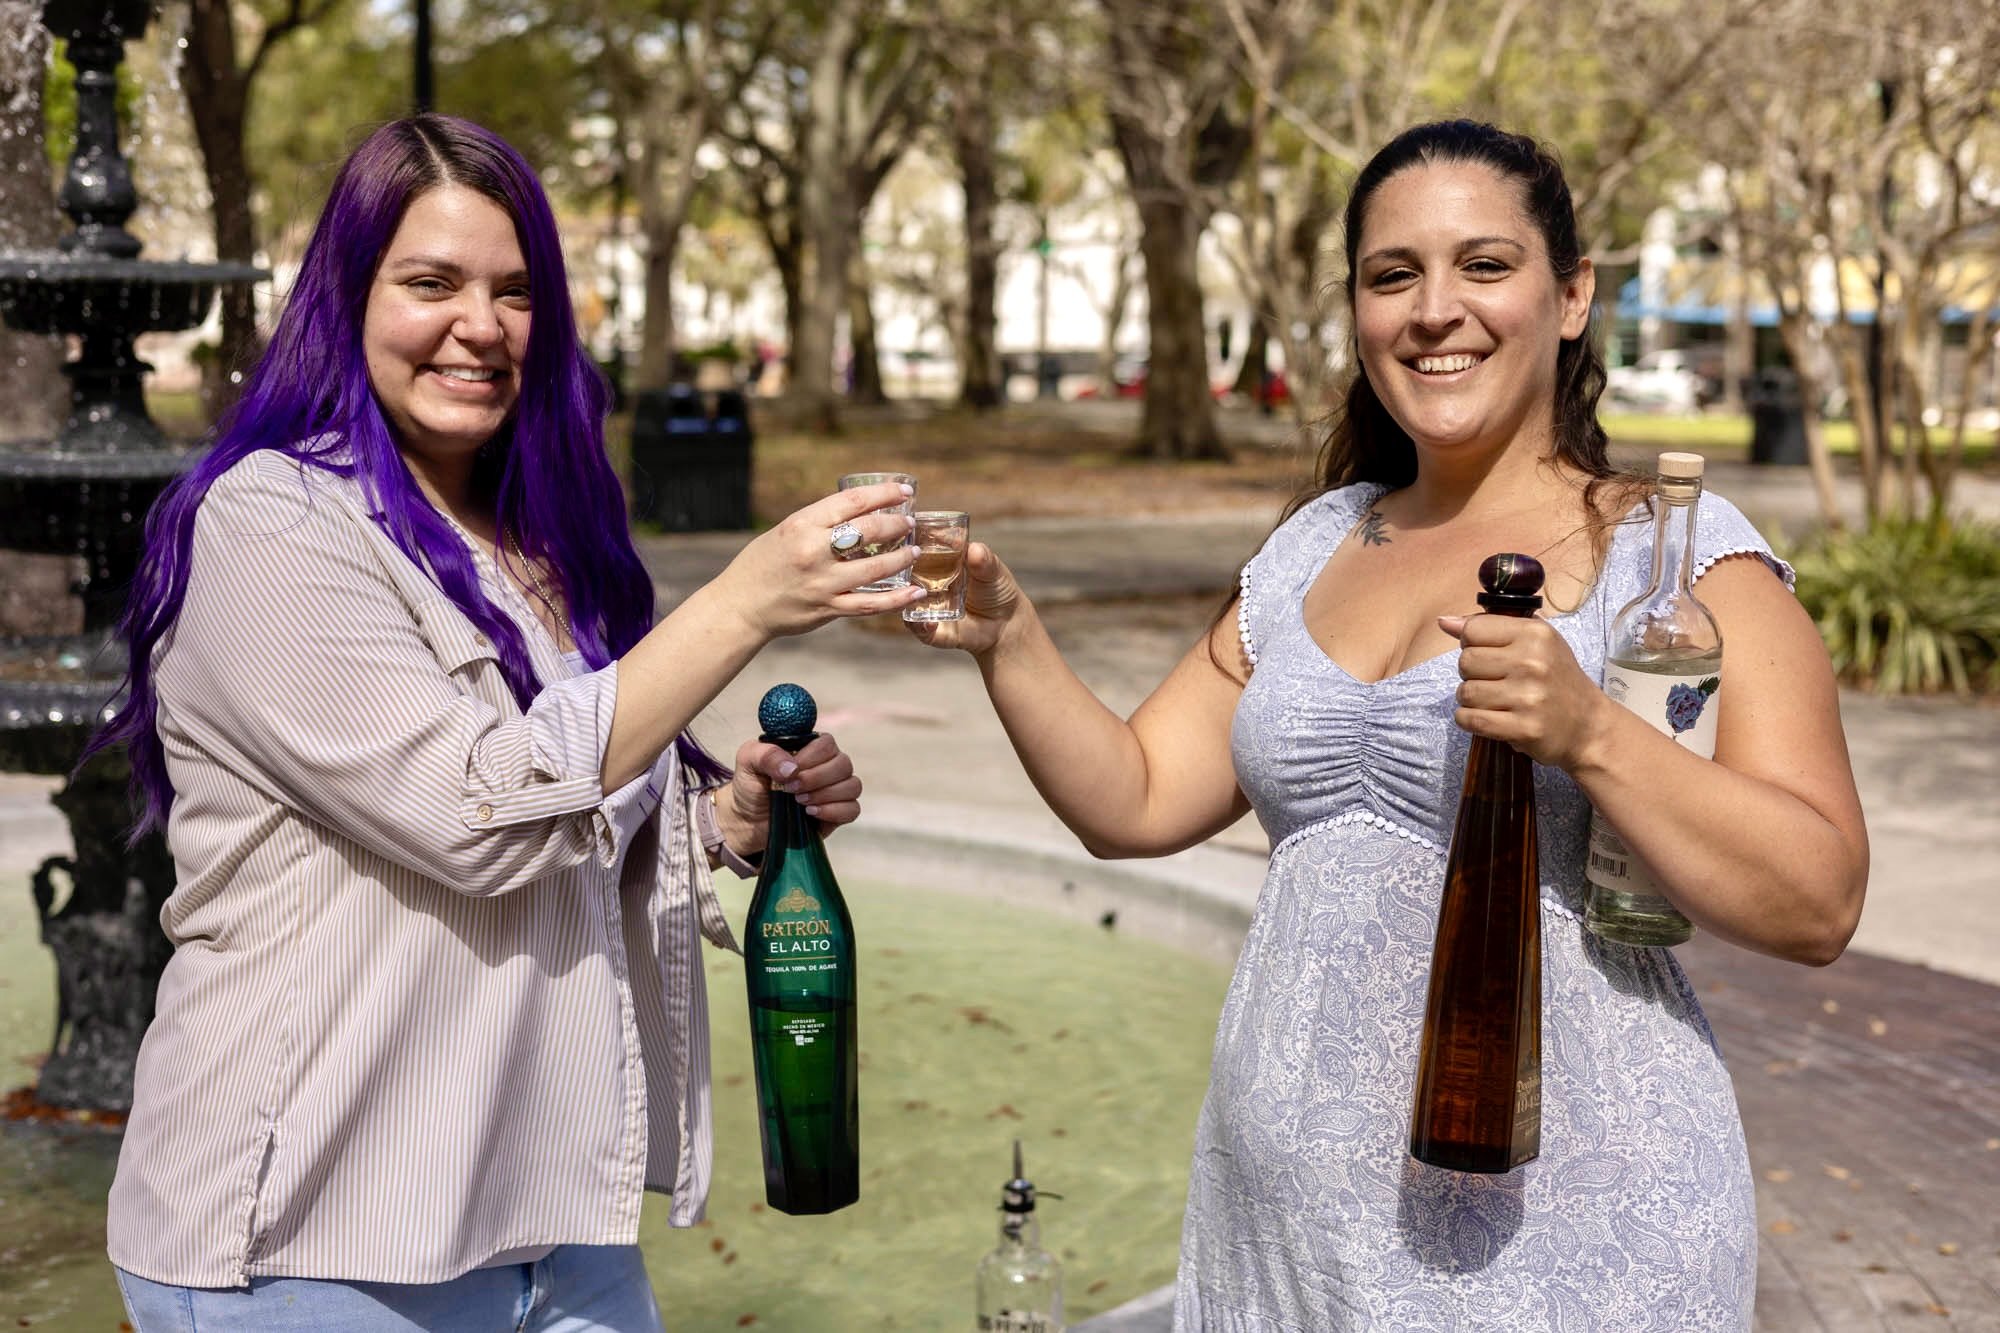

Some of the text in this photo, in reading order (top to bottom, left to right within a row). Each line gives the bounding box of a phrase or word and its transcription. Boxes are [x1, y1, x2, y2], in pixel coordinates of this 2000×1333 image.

[763, 917, 831, 937] PATRÓN
[770, 939, 831, 953] EL ALTO
[819, 963, 837, 971] AGAVE
